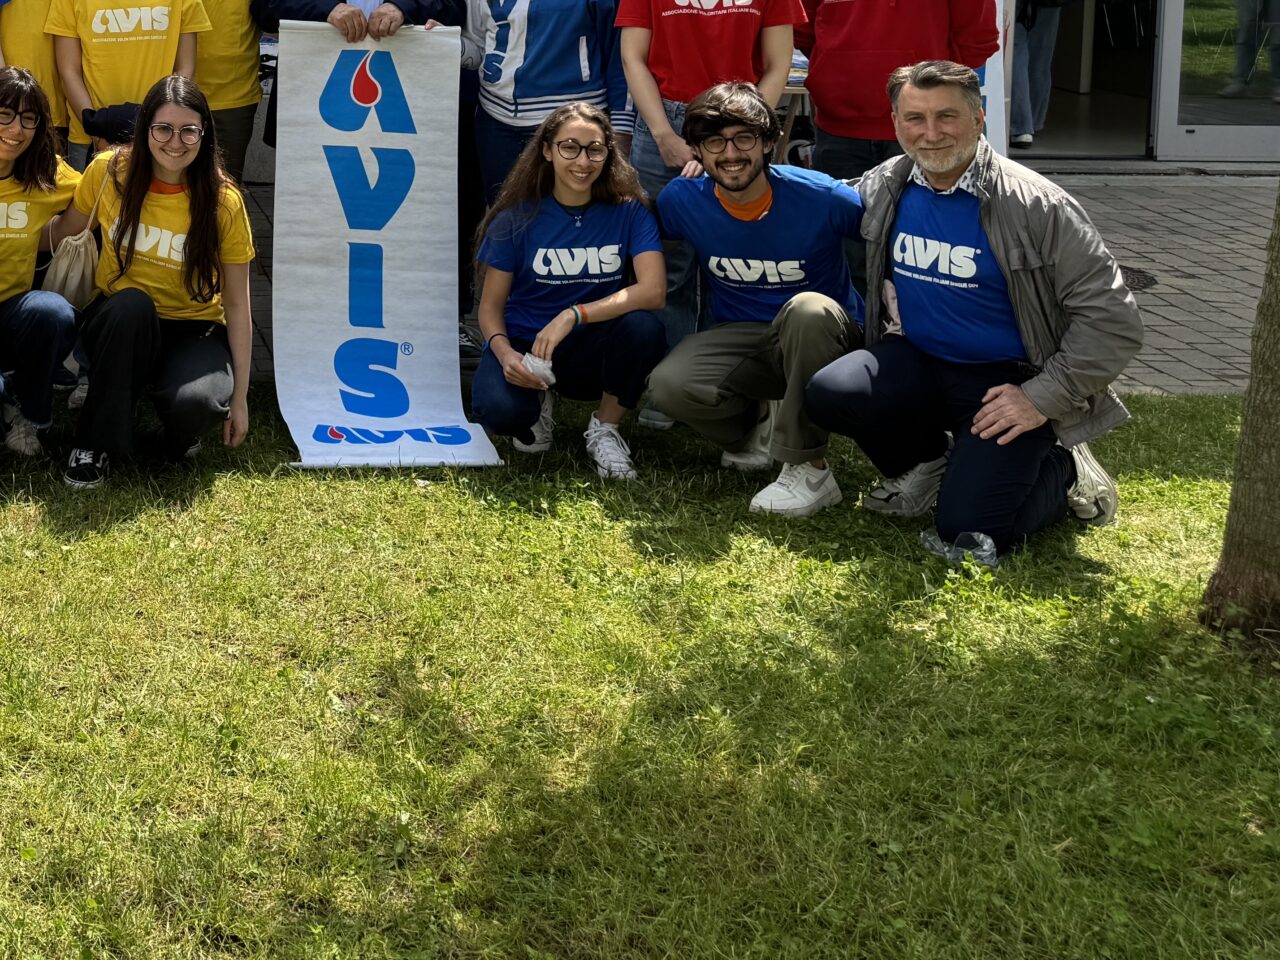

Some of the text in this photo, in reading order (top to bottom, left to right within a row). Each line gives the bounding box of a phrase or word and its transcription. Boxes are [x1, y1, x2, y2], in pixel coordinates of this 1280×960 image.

[91, 6, 170, 34] AVIS
[532, 244, 622, 276] AVIS
[708, 256, 806, 283] AVIS
[893, 232, 977, 279] AVIS
[312, 423, 472, 446] AVIS
